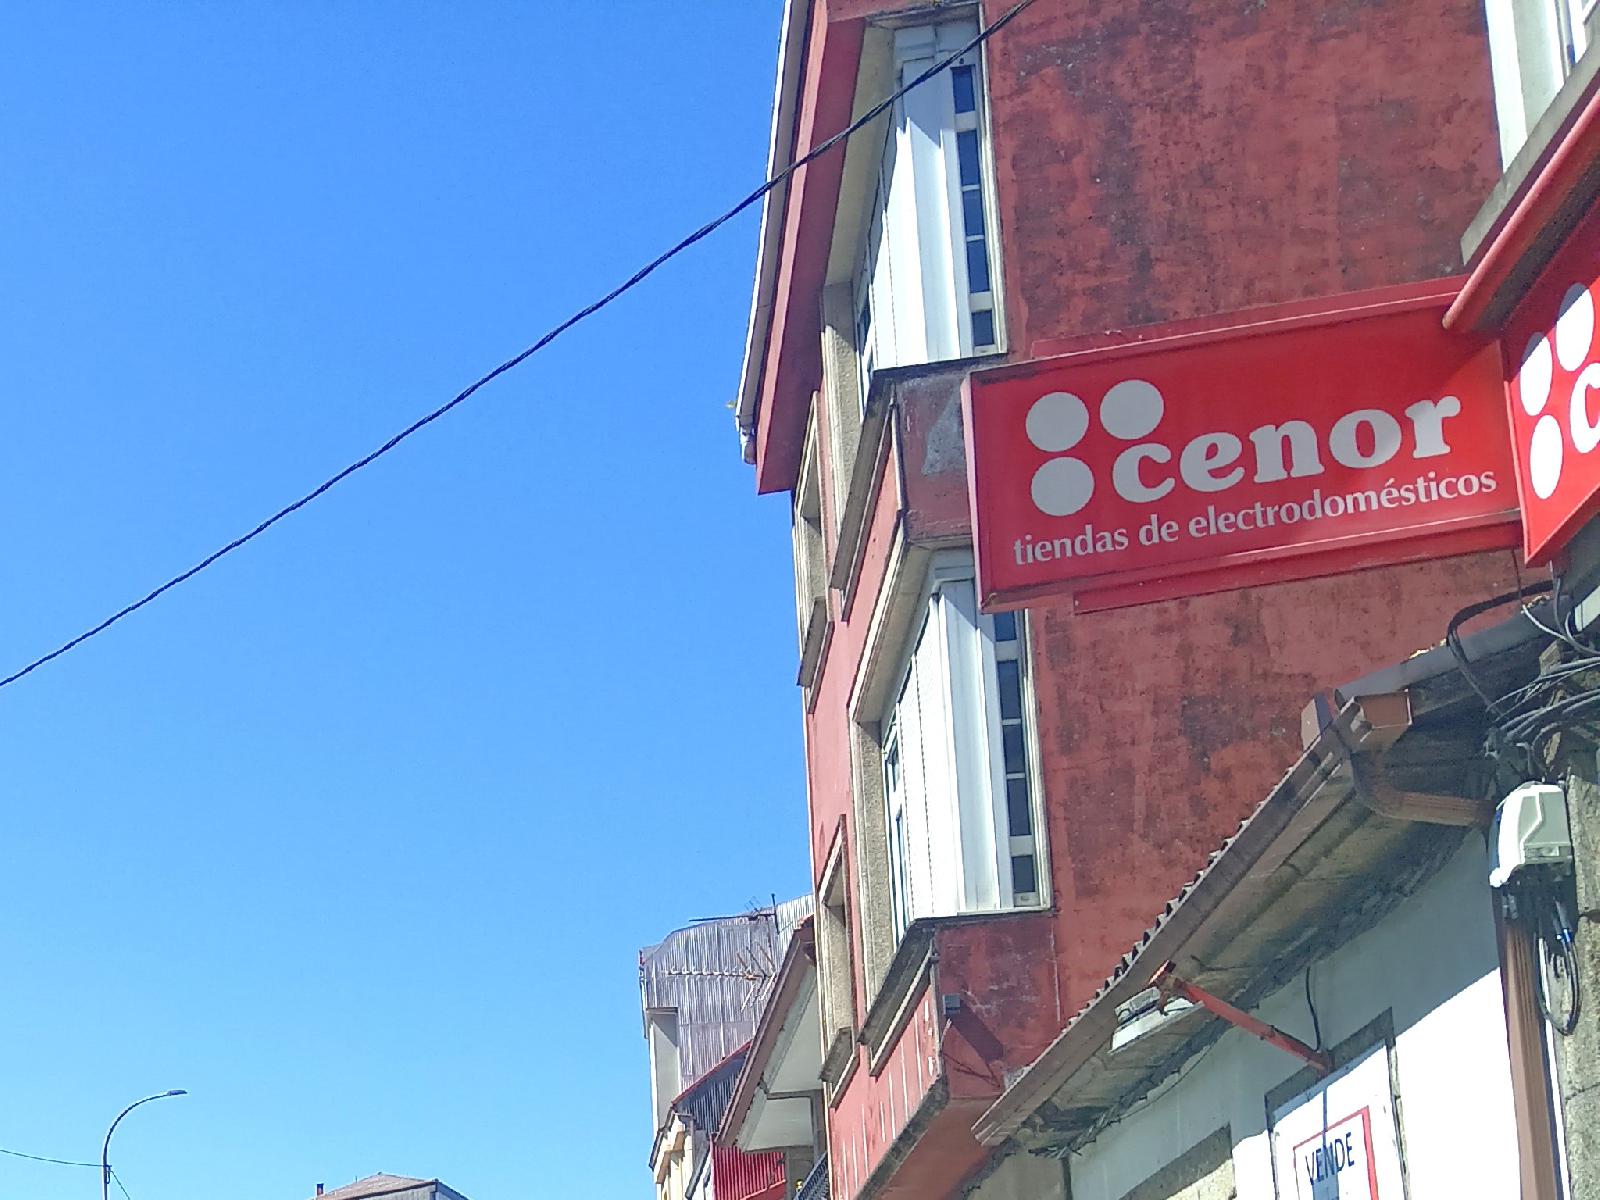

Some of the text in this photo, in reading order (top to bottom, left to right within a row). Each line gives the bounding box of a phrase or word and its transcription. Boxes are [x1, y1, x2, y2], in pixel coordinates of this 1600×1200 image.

[1111, 394, 1462, 504] cenor
[1013, 470, 1498, 567] tiendas de electrodomésticos
[1305, 1131, 1355, 1186] VENDE
